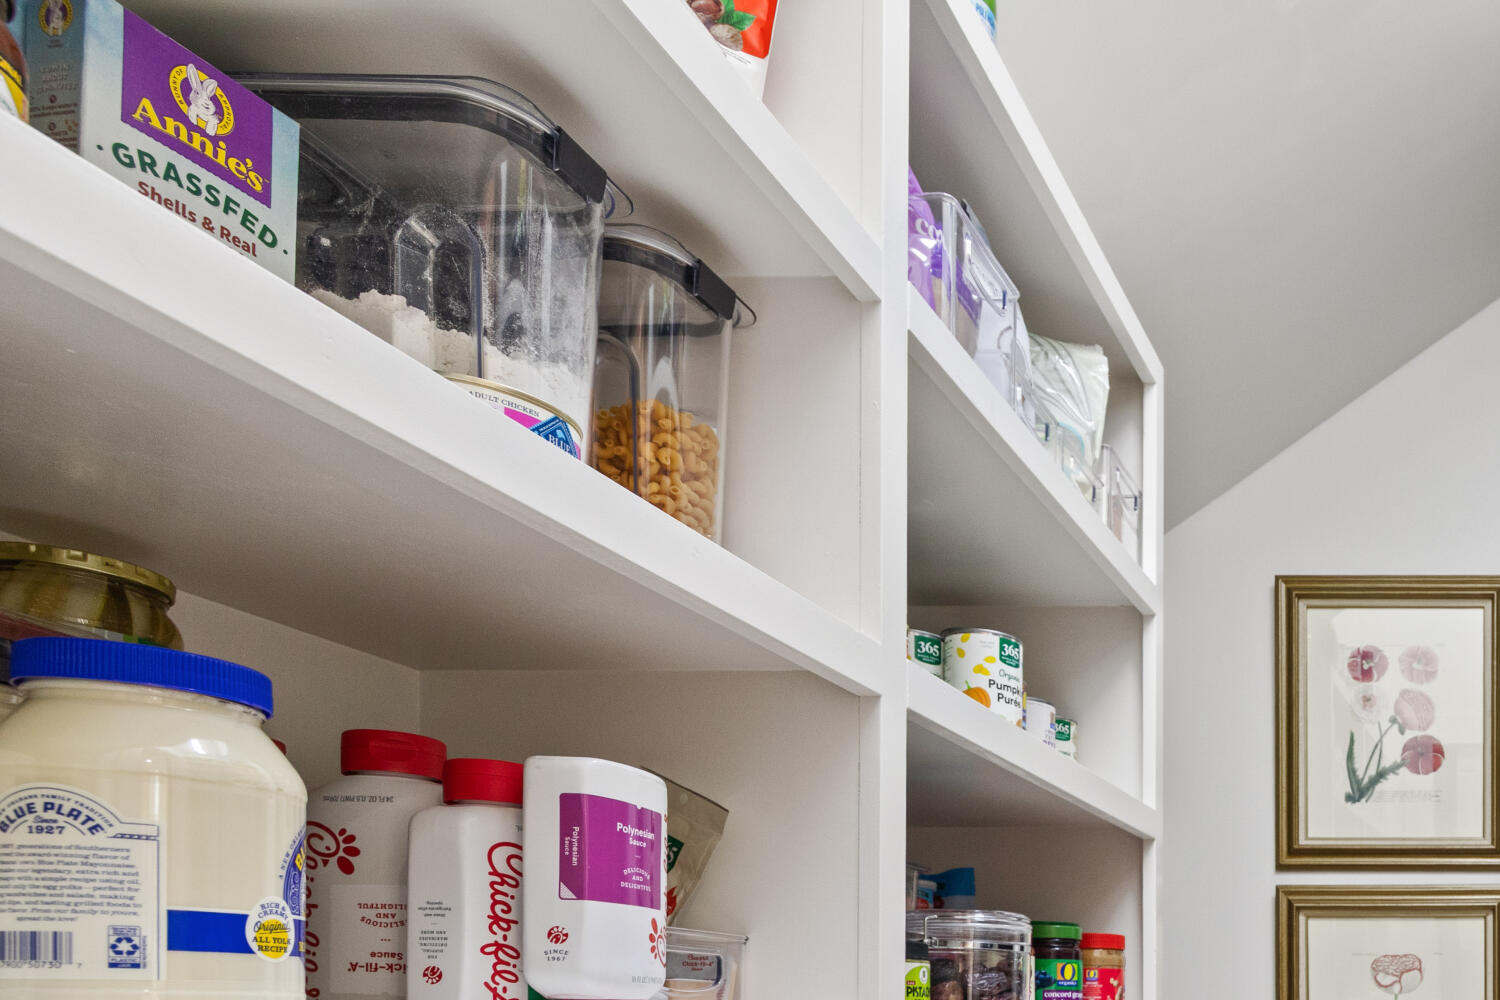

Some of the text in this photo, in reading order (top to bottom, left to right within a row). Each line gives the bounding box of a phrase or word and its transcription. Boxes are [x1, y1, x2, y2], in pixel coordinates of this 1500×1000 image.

[131, 97, 264, 193] Annie's
[111, 142, 278, 249] GRASSFED
[137, 181, 257, 257] Shells & Real
[501, 399, 540, 417] CHICKEN
[917, 641, 940, 657] 365
[1001, 644, 1020, 660] 365
[988, 679, 1020, 696] Pumpk
[0, 801, 105, 836] BLUE PLATE
[32, 816, 59, 824] Since
[27, 825, 66, 834] 1927
[616, 822, 655, 840] Polynesian
[572, 826, 580, 867] Polynesian
[629, 836, 647, 848] Sauce
[632, 874, 644, 882] AND
[620, 882, 652, 892] DELIGHTFUL
[260, 902, 280, 910] RICH
[357, 902, 407, 910] LIGHTFUL
[258, 909, 289, 922] CREAMY
[253, 920, 290, 934] Original
[360, 917, 408, 928] ELICIOUS
[252, 936, 292, 945] ALL YOLK
[257, 944, 289, 954] RECIPE
[370, 952, 404, 960] Sauce
[348, 962, 408, 974] ick-fil-A
[1072, 992, 1082, 1000] gra
